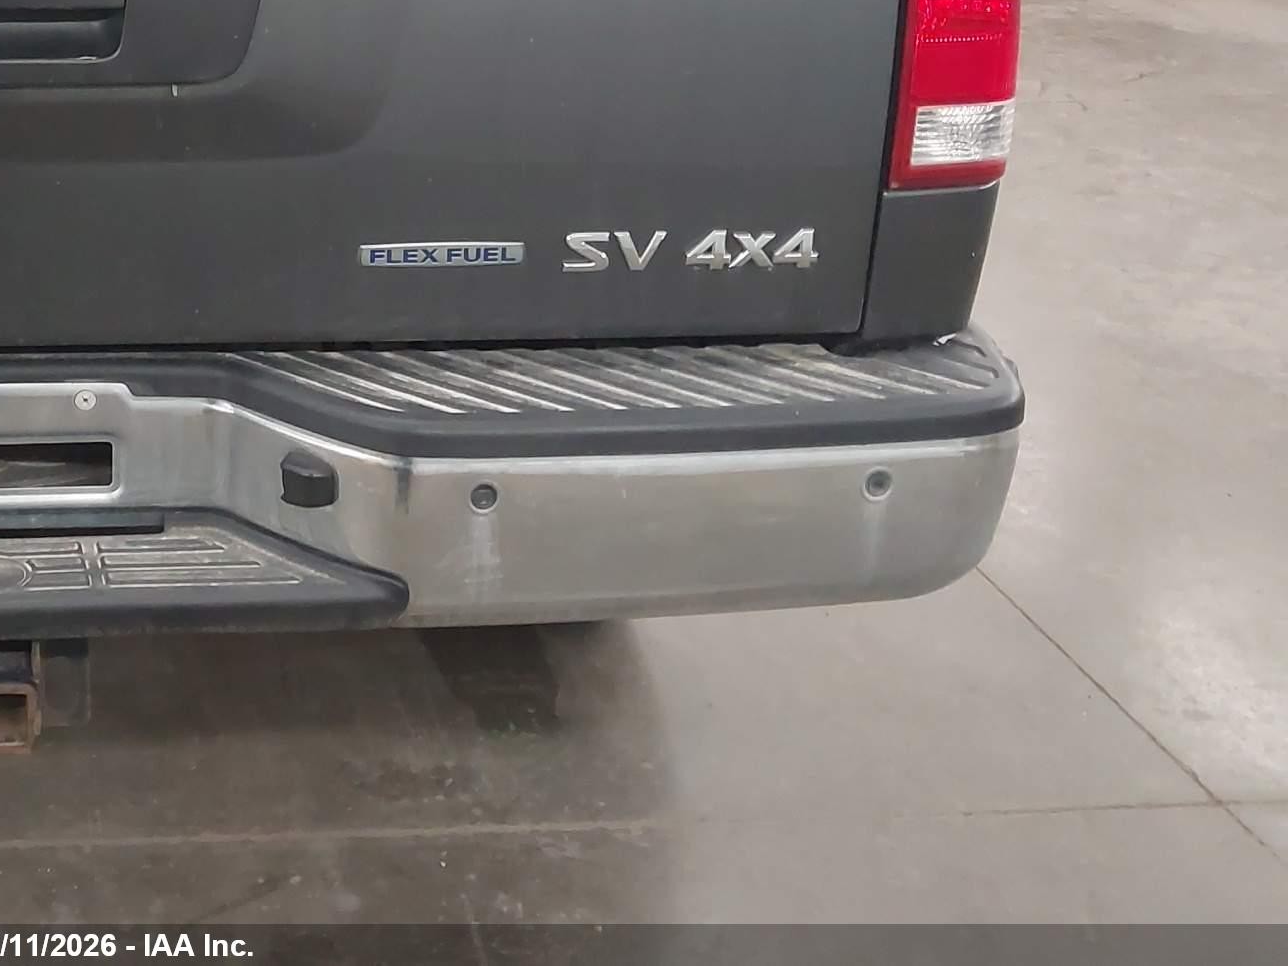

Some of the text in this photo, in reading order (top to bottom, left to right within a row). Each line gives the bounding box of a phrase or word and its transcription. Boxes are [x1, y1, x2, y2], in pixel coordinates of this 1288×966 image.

[368, 247, 517, 265] FLEX FUEL
[562, 230, 668, 273] SV
